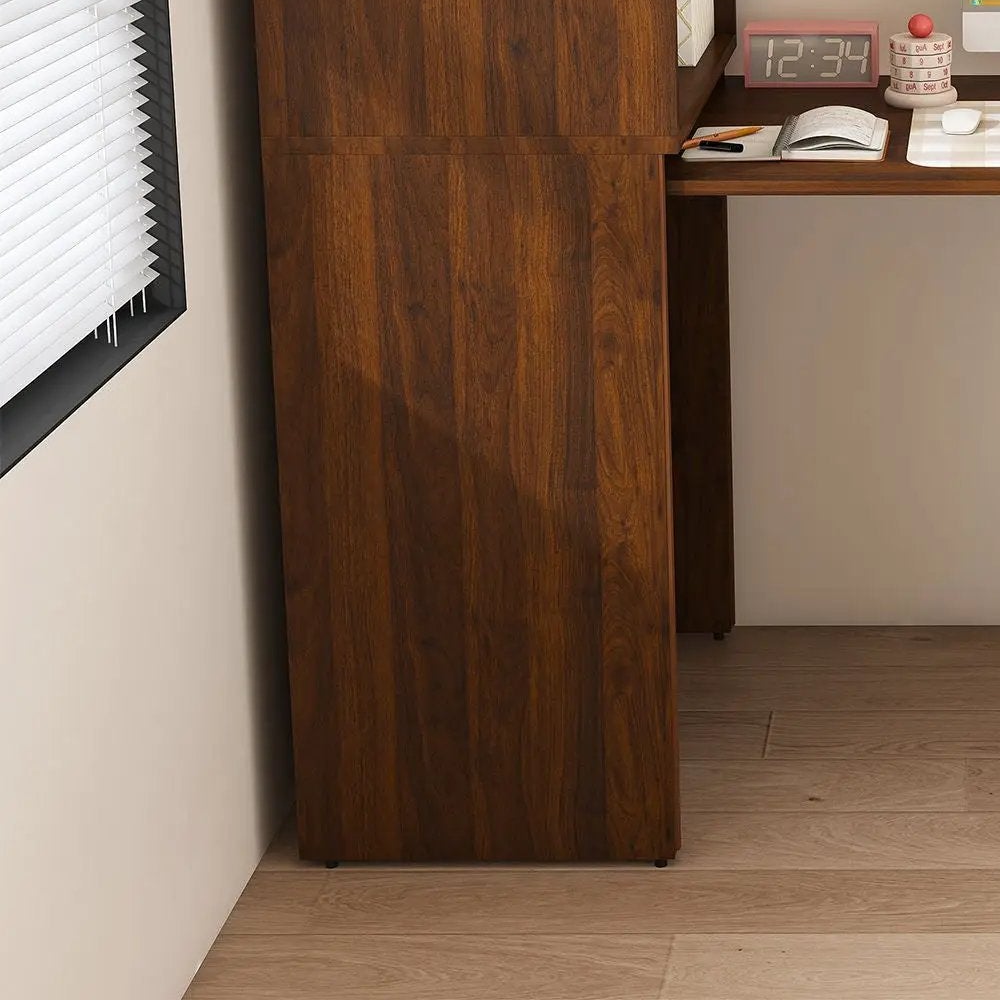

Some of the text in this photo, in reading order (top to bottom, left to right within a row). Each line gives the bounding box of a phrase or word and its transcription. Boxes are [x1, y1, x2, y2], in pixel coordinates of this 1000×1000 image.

[933, 43, 945, 51] Sept
[765, 38, 870, 78] 12:34
[923, 83, 937, 91] Sept
